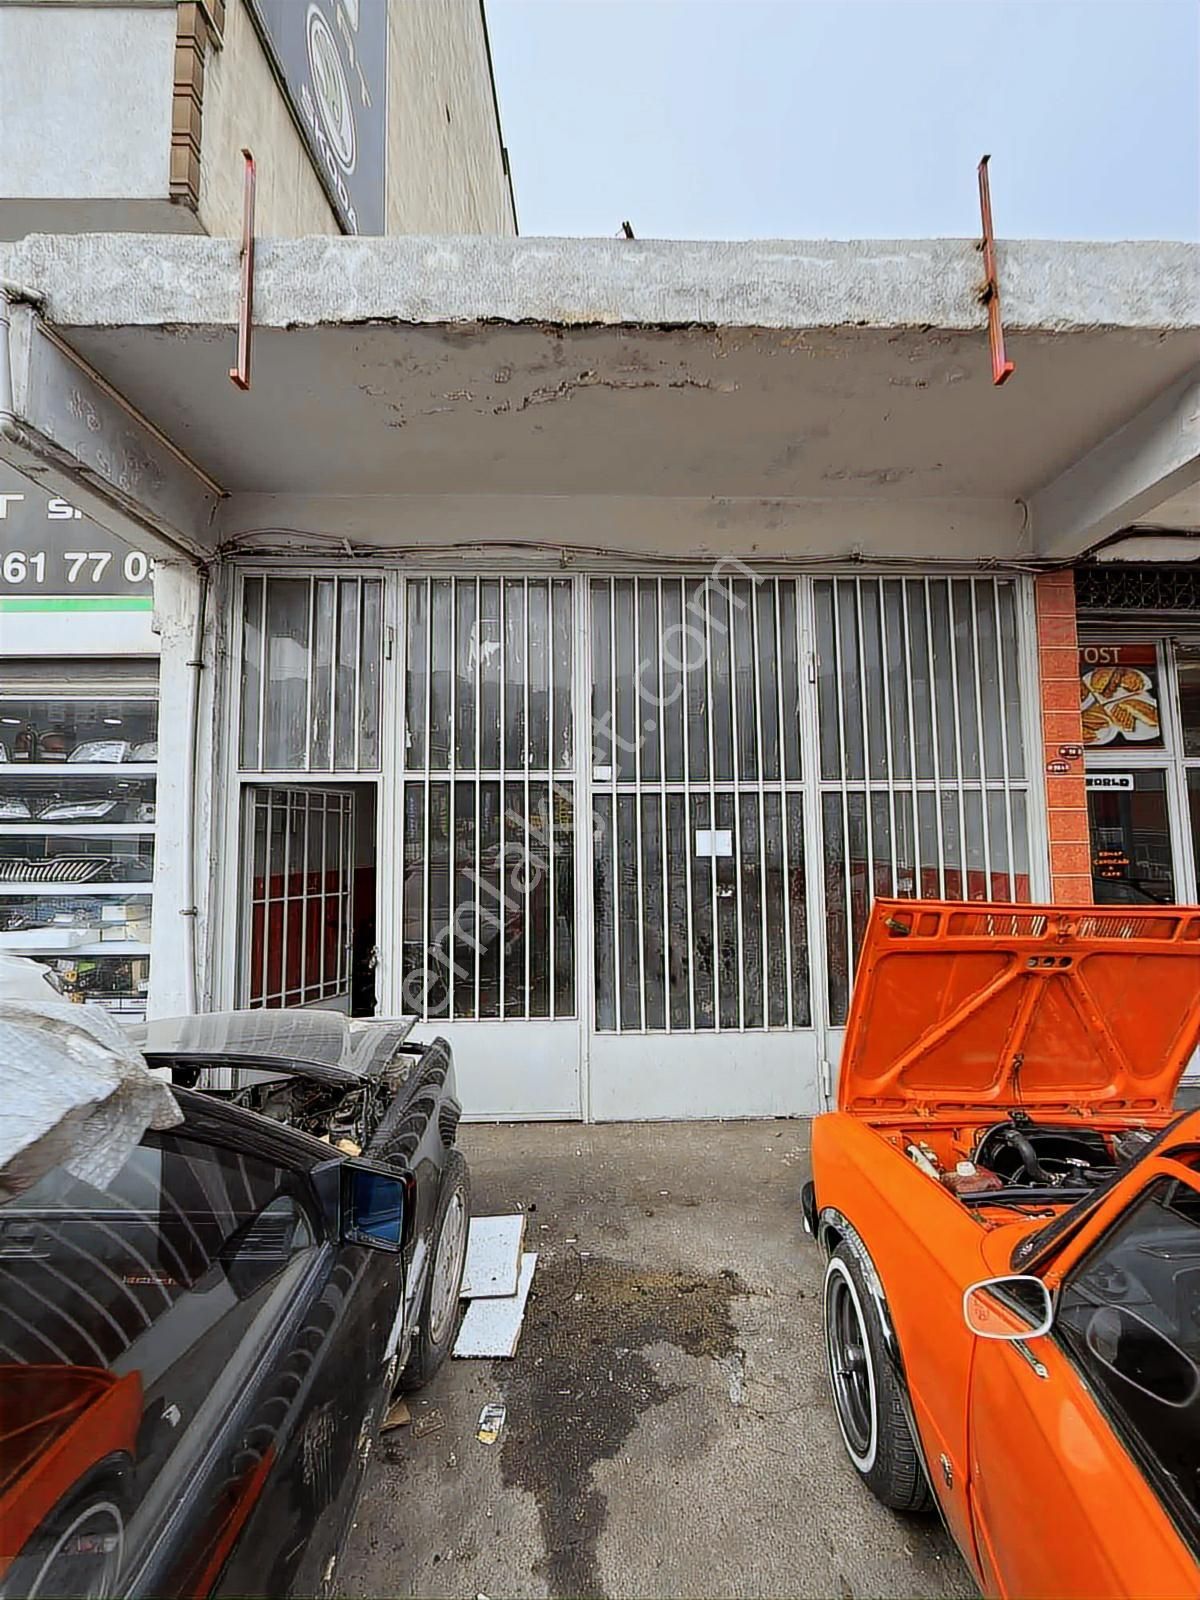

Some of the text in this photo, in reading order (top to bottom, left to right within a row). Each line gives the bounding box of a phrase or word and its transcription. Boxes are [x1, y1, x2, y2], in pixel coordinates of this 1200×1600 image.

[47, 497, 82, 519] S
[0, 551, 155, 583] 61 77 0
